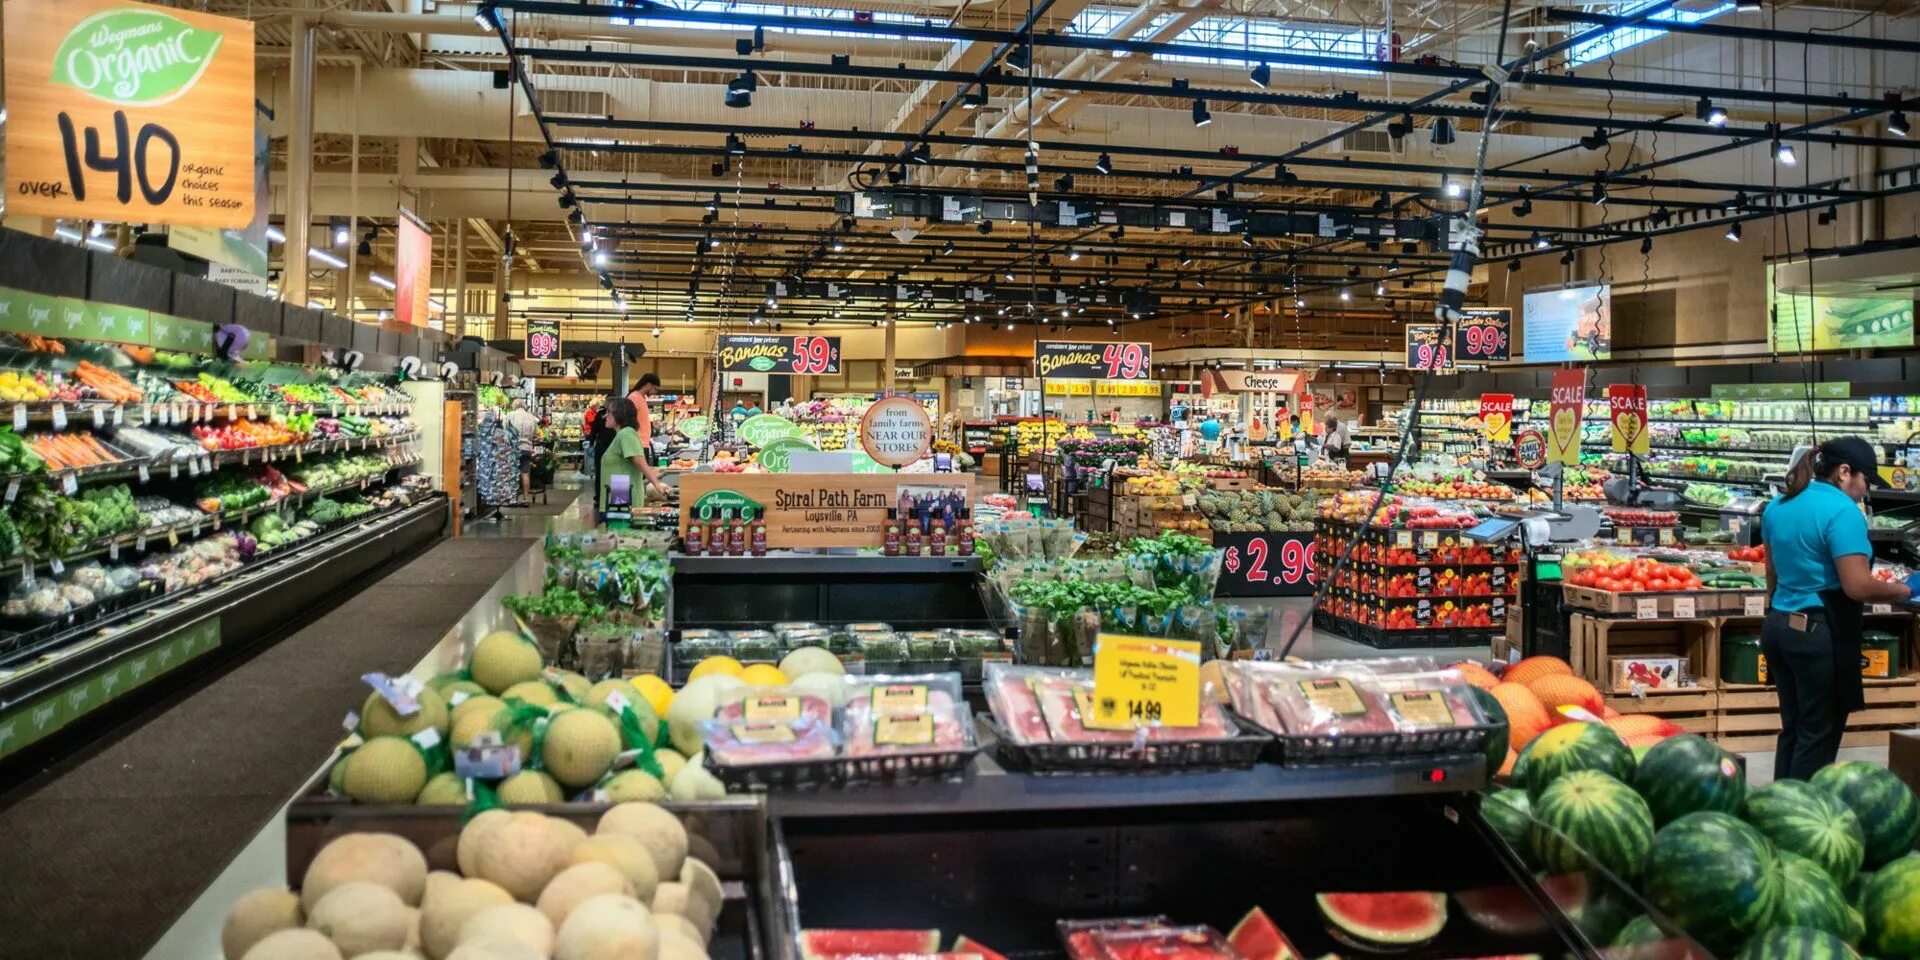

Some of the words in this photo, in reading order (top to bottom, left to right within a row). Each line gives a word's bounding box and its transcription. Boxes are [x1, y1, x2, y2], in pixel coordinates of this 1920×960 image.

[89, 20, 163, 49] Wegmans
[67, 28, 200, 98] Organic
[19, 180, 68, 197] over
[57, 110, 181, 205] 140
[182, 164, 224, 178] organic
[182, 179, 219, 191] choices
[182, 194, 204, 207] this
[209, 198, 243, 209] season
[1467, 326, 1508, 355] 99¢
[719, 345, 788, 369] Bananas
[1040, 352, 1101, 375] Bananas
[541, 361, 568, 375] Floral
[1244, 374, 1279, 389] Cheese
[1552, 385, 1582, 405] SCALE
[886, 407, 907, 416] from
[1482, 401, 1512, 411] SCALE
[870, 418, 896, 430] family
[899, 418, 924, 427] farms
[742, 424, 796, 446] Organic
[867, 431, 898, 440] NEAR
[901, 431, 927, 440] OUR
[875, 443, 918, 452] STORES
[1518, 442, 1542, 455] FAMILY
[1520, 451, 1541, 463] PACK
[706, 494, 745, 508] Wegmans
[775, 489, 815, 511] Spiral
[819, 489, 849, 507] Path
[853, 489, 887, 507] Farm
[847, 510, 858, 521] PA
